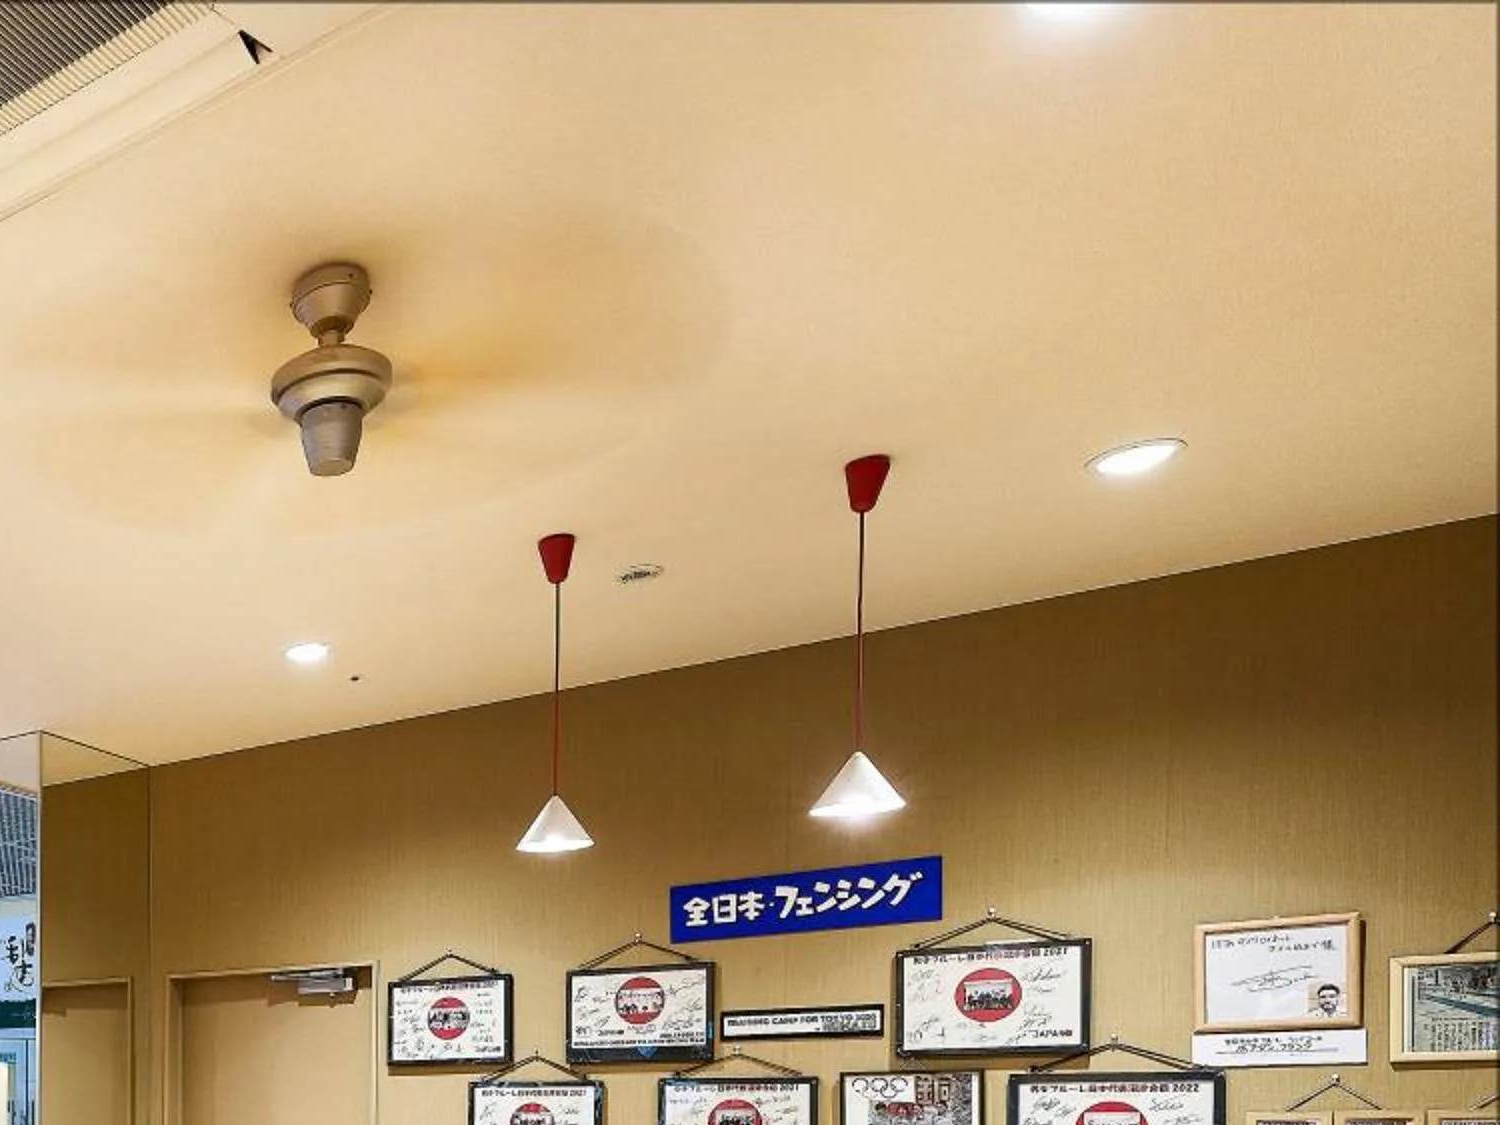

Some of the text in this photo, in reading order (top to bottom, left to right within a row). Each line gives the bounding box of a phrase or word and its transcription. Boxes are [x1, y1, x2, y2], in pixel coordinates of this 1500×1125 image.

[683, 870, 923, 927] 全日本・フェンシング
[1173, 1083, 1200, 1093] 2022
